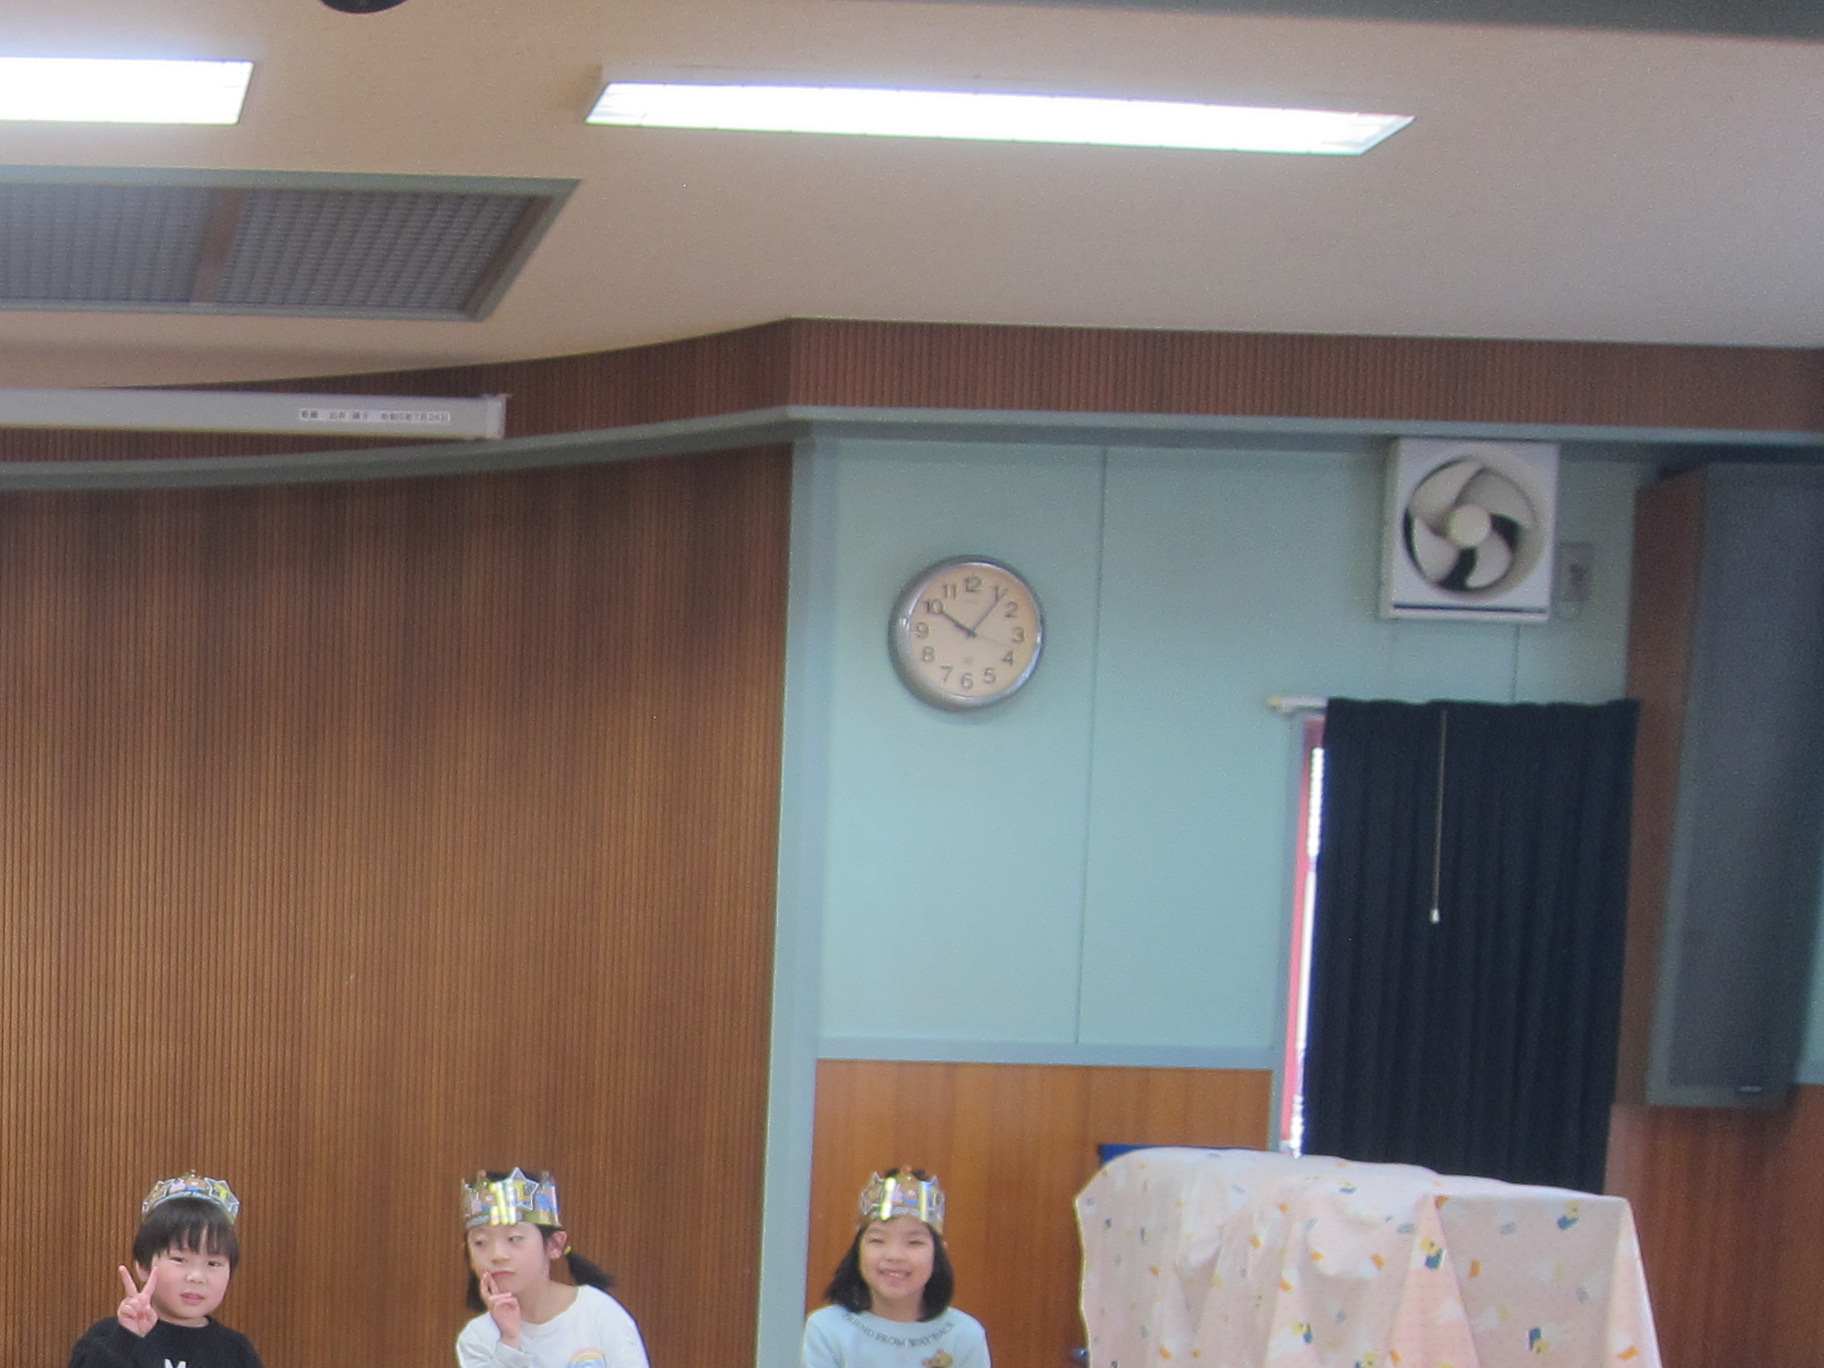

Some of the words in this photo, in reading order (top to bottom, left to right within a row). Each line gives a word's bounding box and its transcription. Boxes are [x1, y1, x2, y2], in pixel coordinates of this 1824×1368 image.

[942, 583, 958, 599] 11
[963, 576, 981, 593] 12
[925, 599, 944, 615] 10
[1005, 602, 1018, 618] 2
[916, 622, 929, 638] 9
[1012, 627, 1025, 643] 3
[922, 646, 935, 662] 8
[1001, 651, 1014, 666] 4
[941, 665, 954, 682] 7
[961, 673, 974, 690] 6
[984, 668, 996, 684] 5
